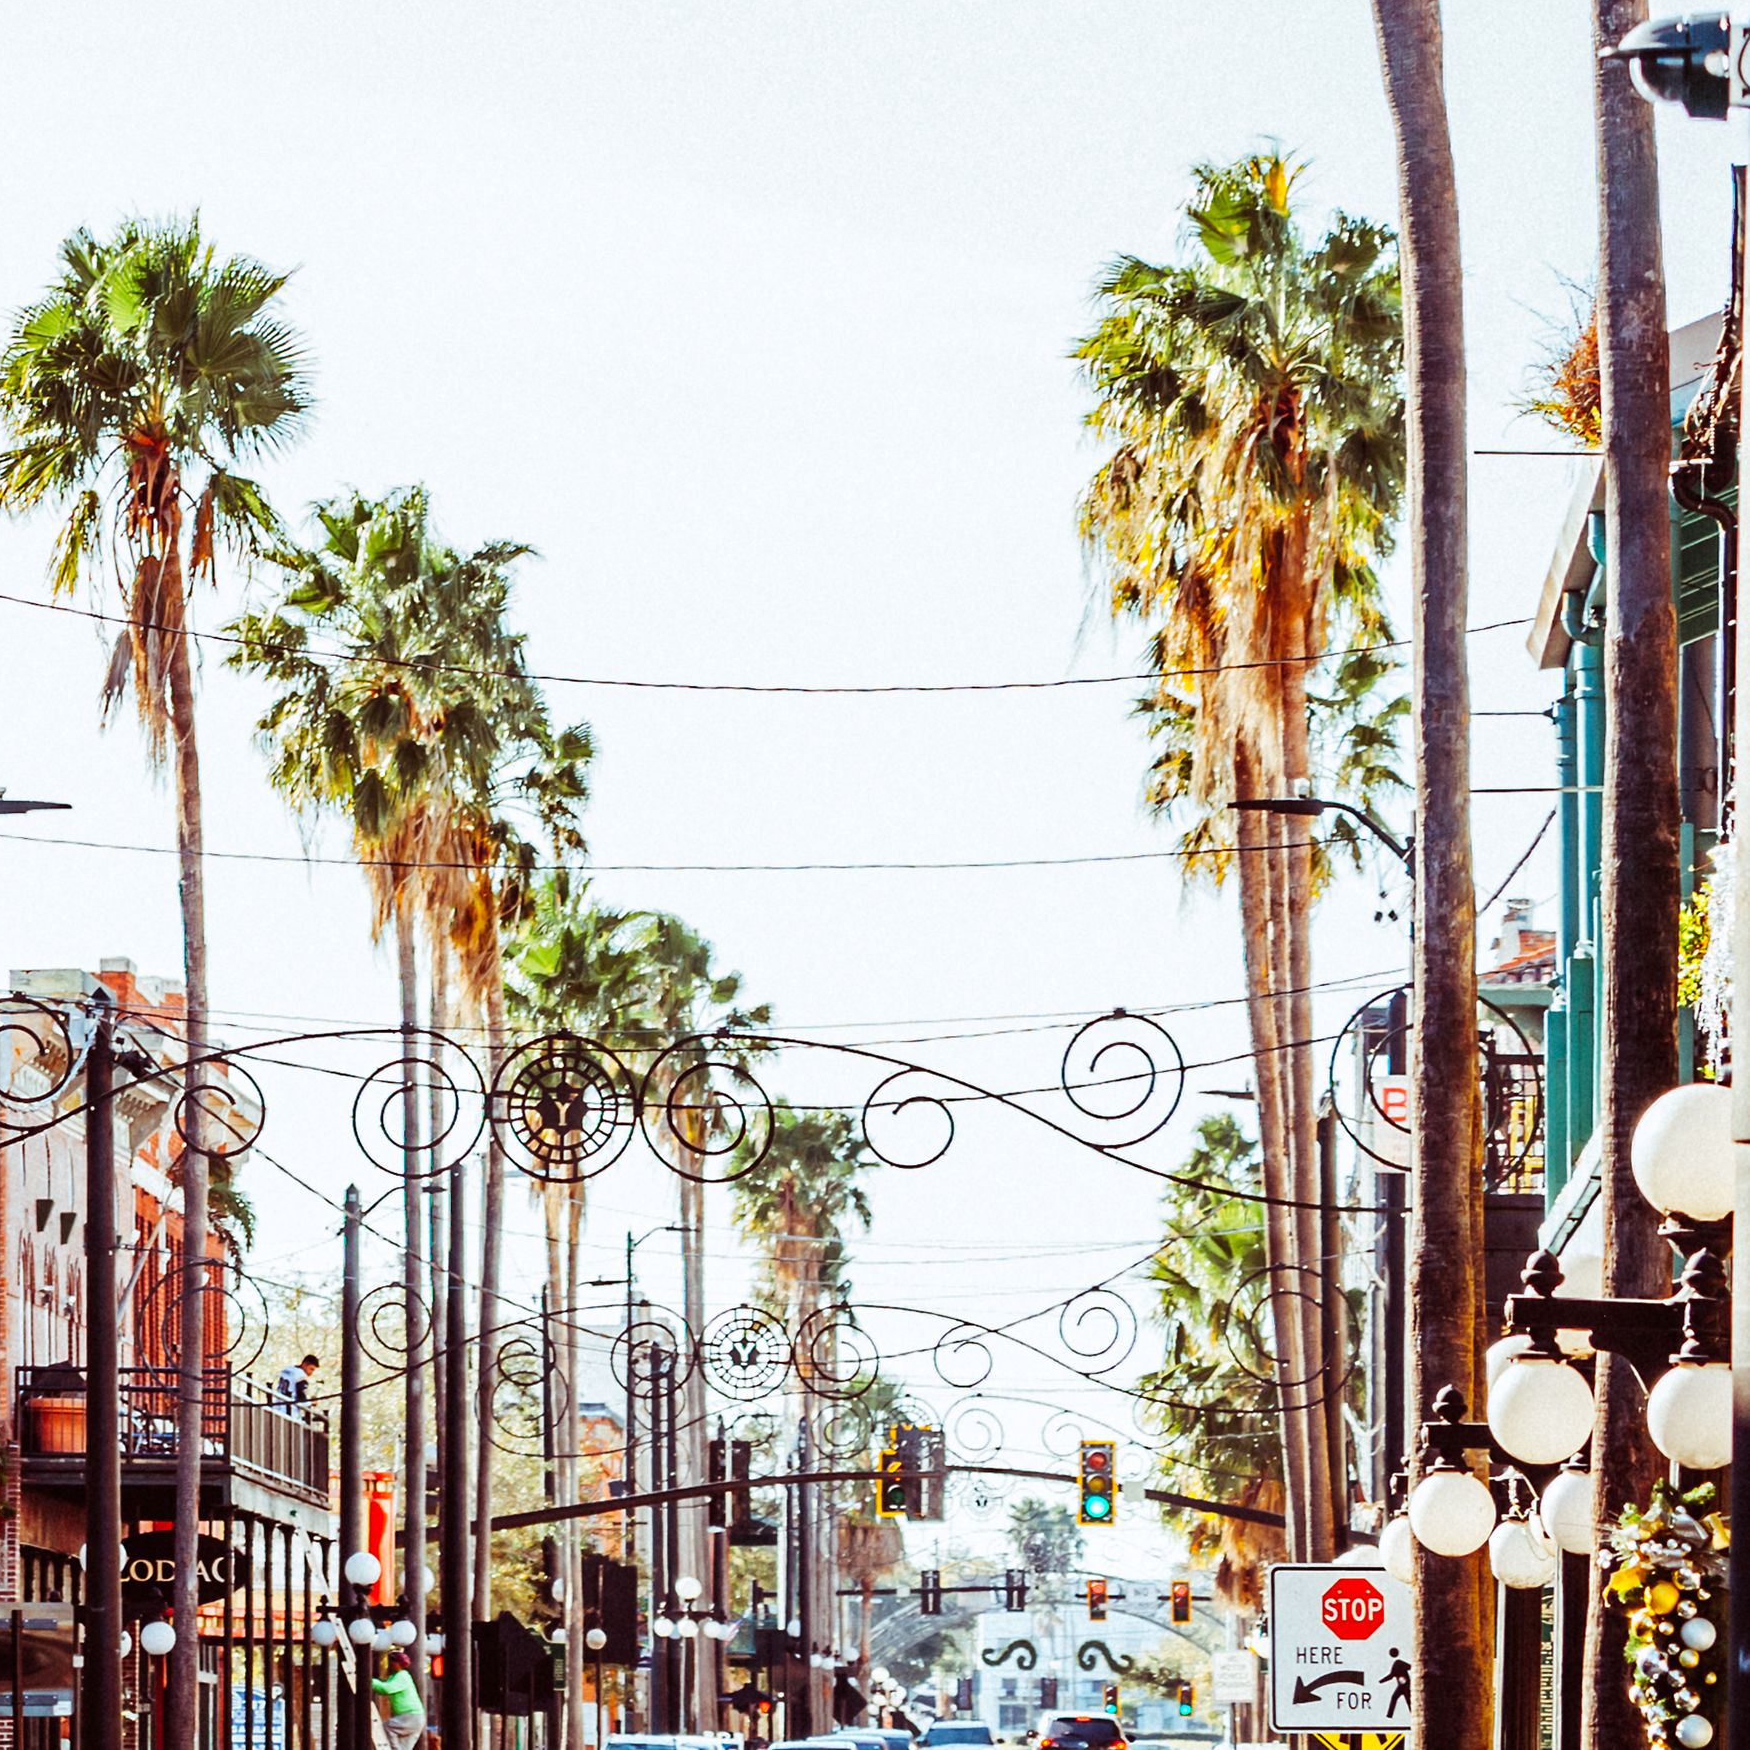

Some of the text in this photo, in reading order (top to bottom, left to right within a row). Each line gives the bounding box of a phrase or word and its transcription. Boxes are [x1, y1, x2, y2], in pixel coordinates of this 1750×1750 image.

[1323, 1597, 1383, 1622] STOP
[1296, 1646, 1344, 1665] HERE
[1337, 1692, 1372, 1710] FOR
